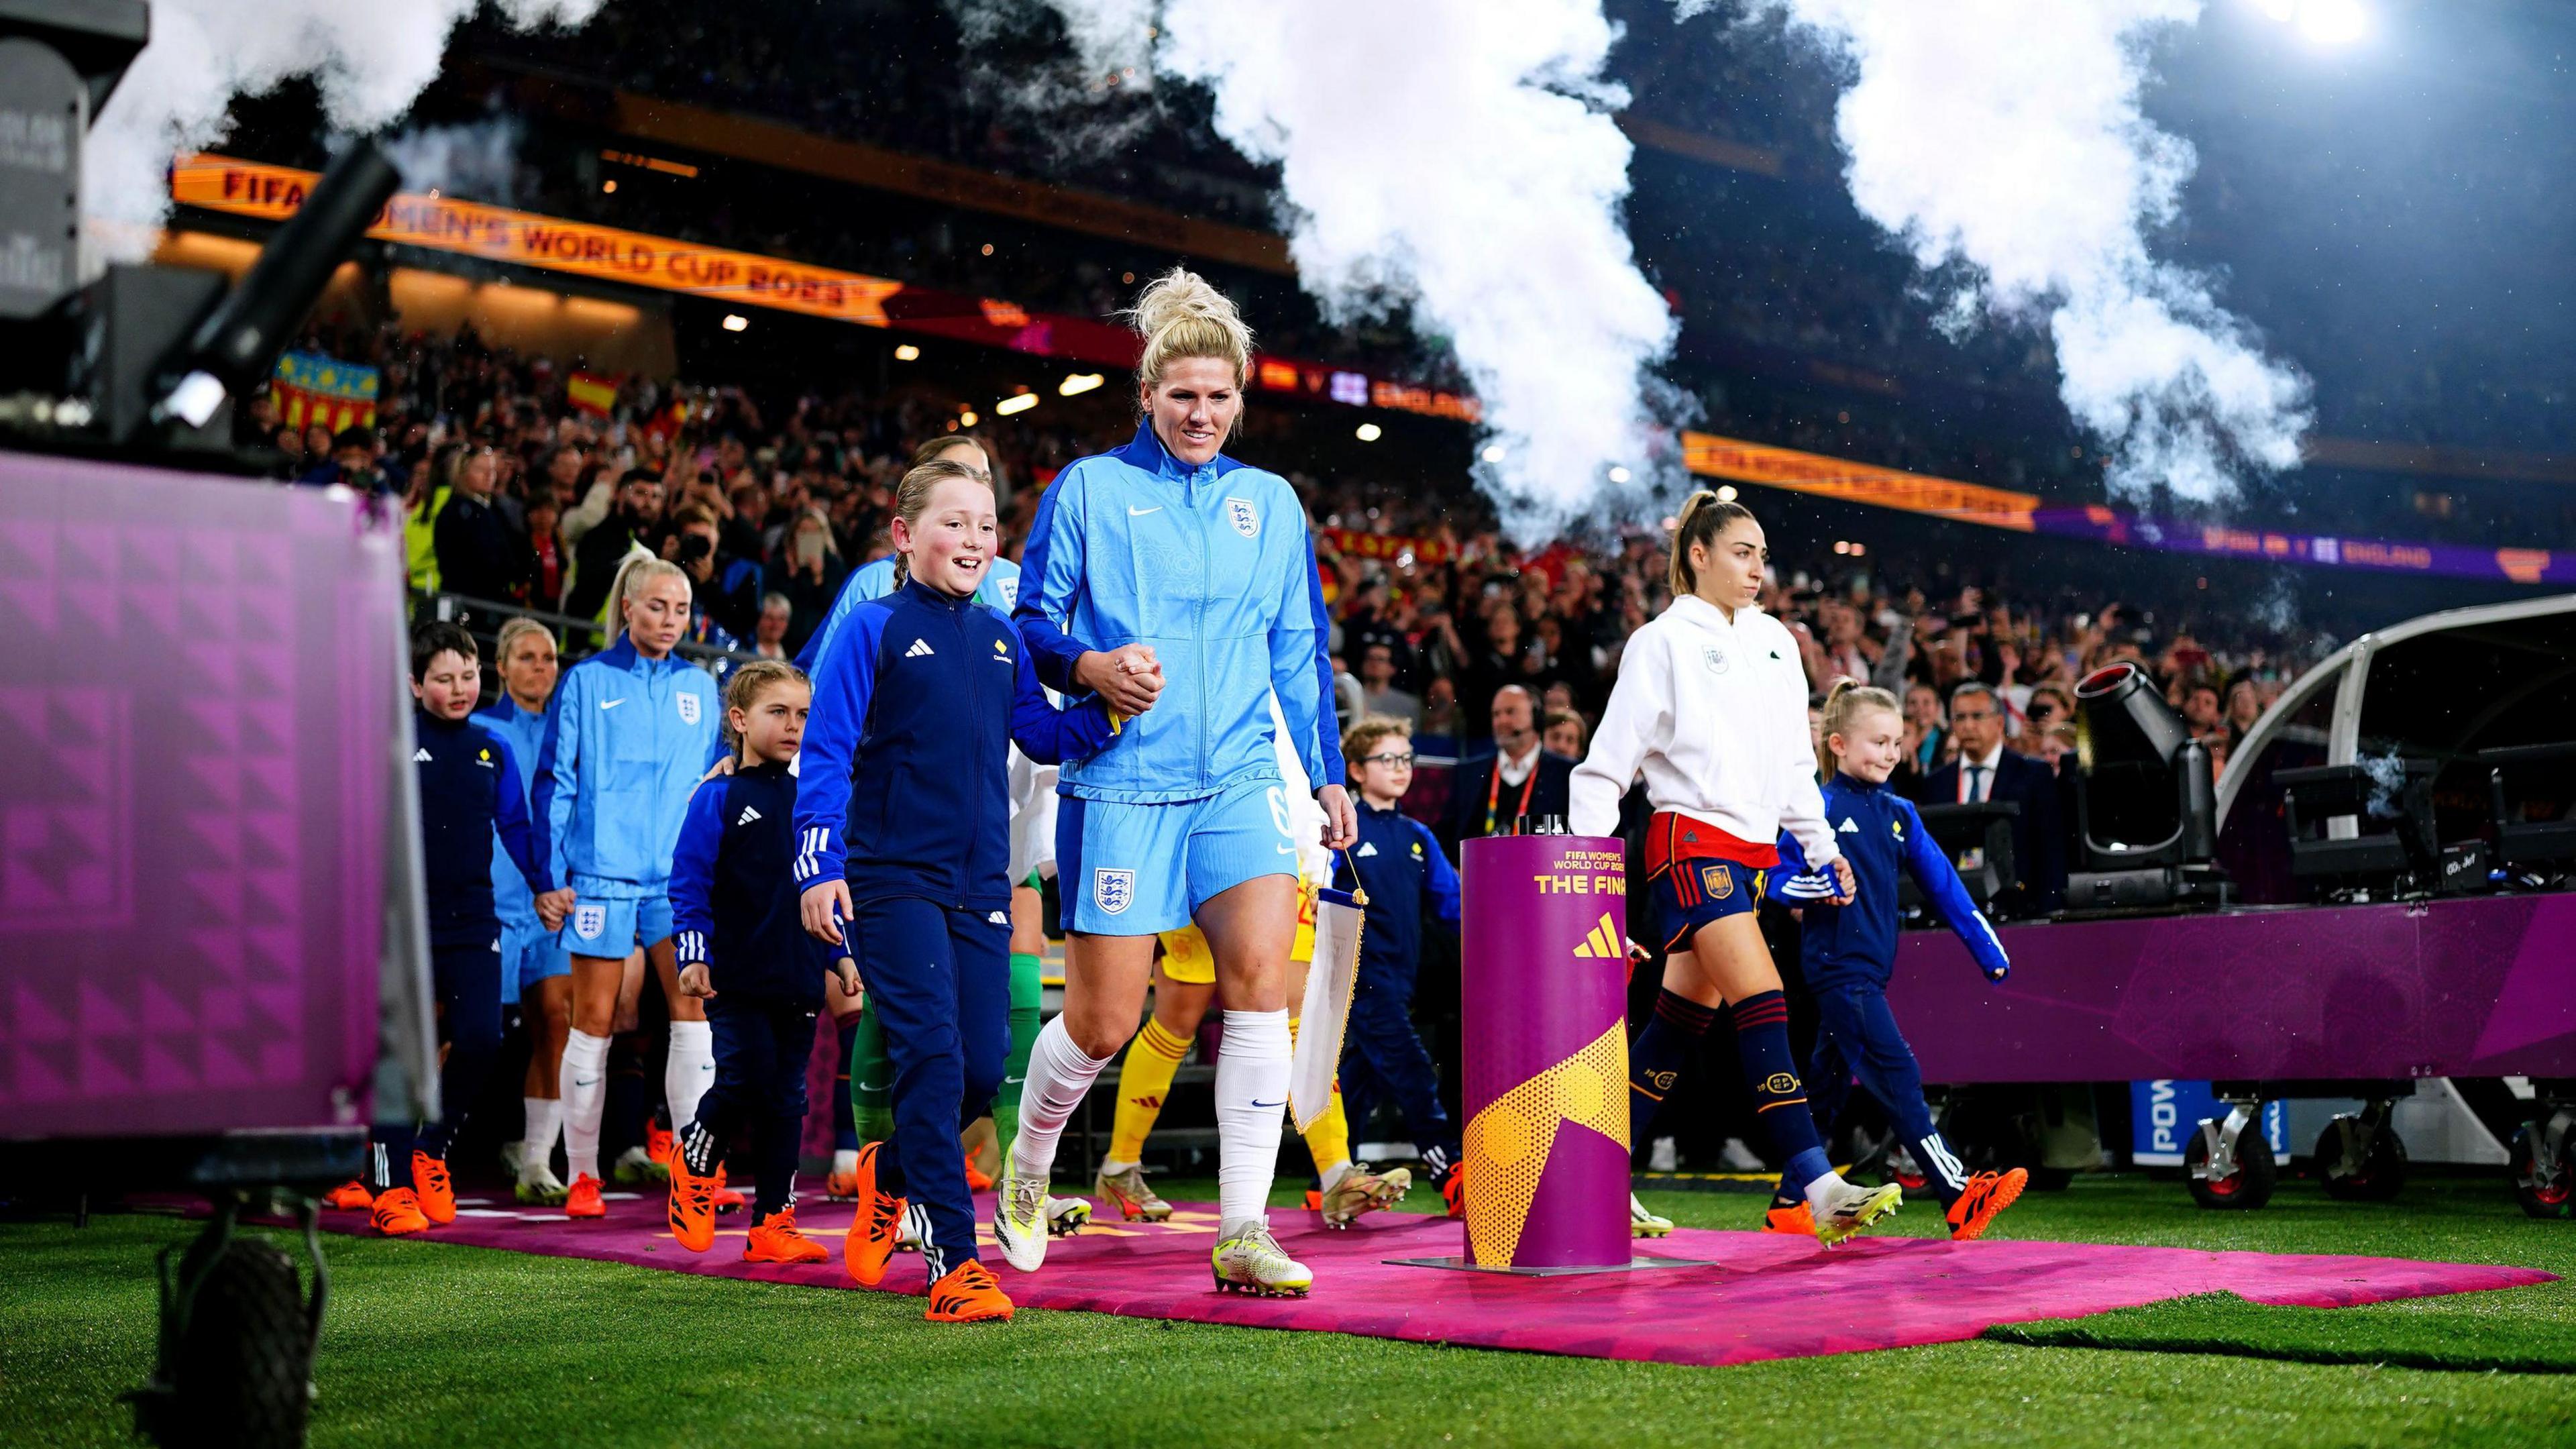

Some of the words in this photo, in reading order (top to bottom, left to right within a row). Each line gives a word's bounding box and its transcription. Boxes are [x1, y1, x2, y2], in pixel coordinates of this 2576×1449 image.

[523, 223, 655, 274] WORLD
[666, 251, 735, 284] CUP
[1565, 851, 1587, 860] FIFA
[1588, 851, 1621, 861] WOMEN'S
[1554, 861, 1592, 869] WORLD
[1593, 861, 1609, 871] CUP
[1534, 875, 1589, 894] THE
